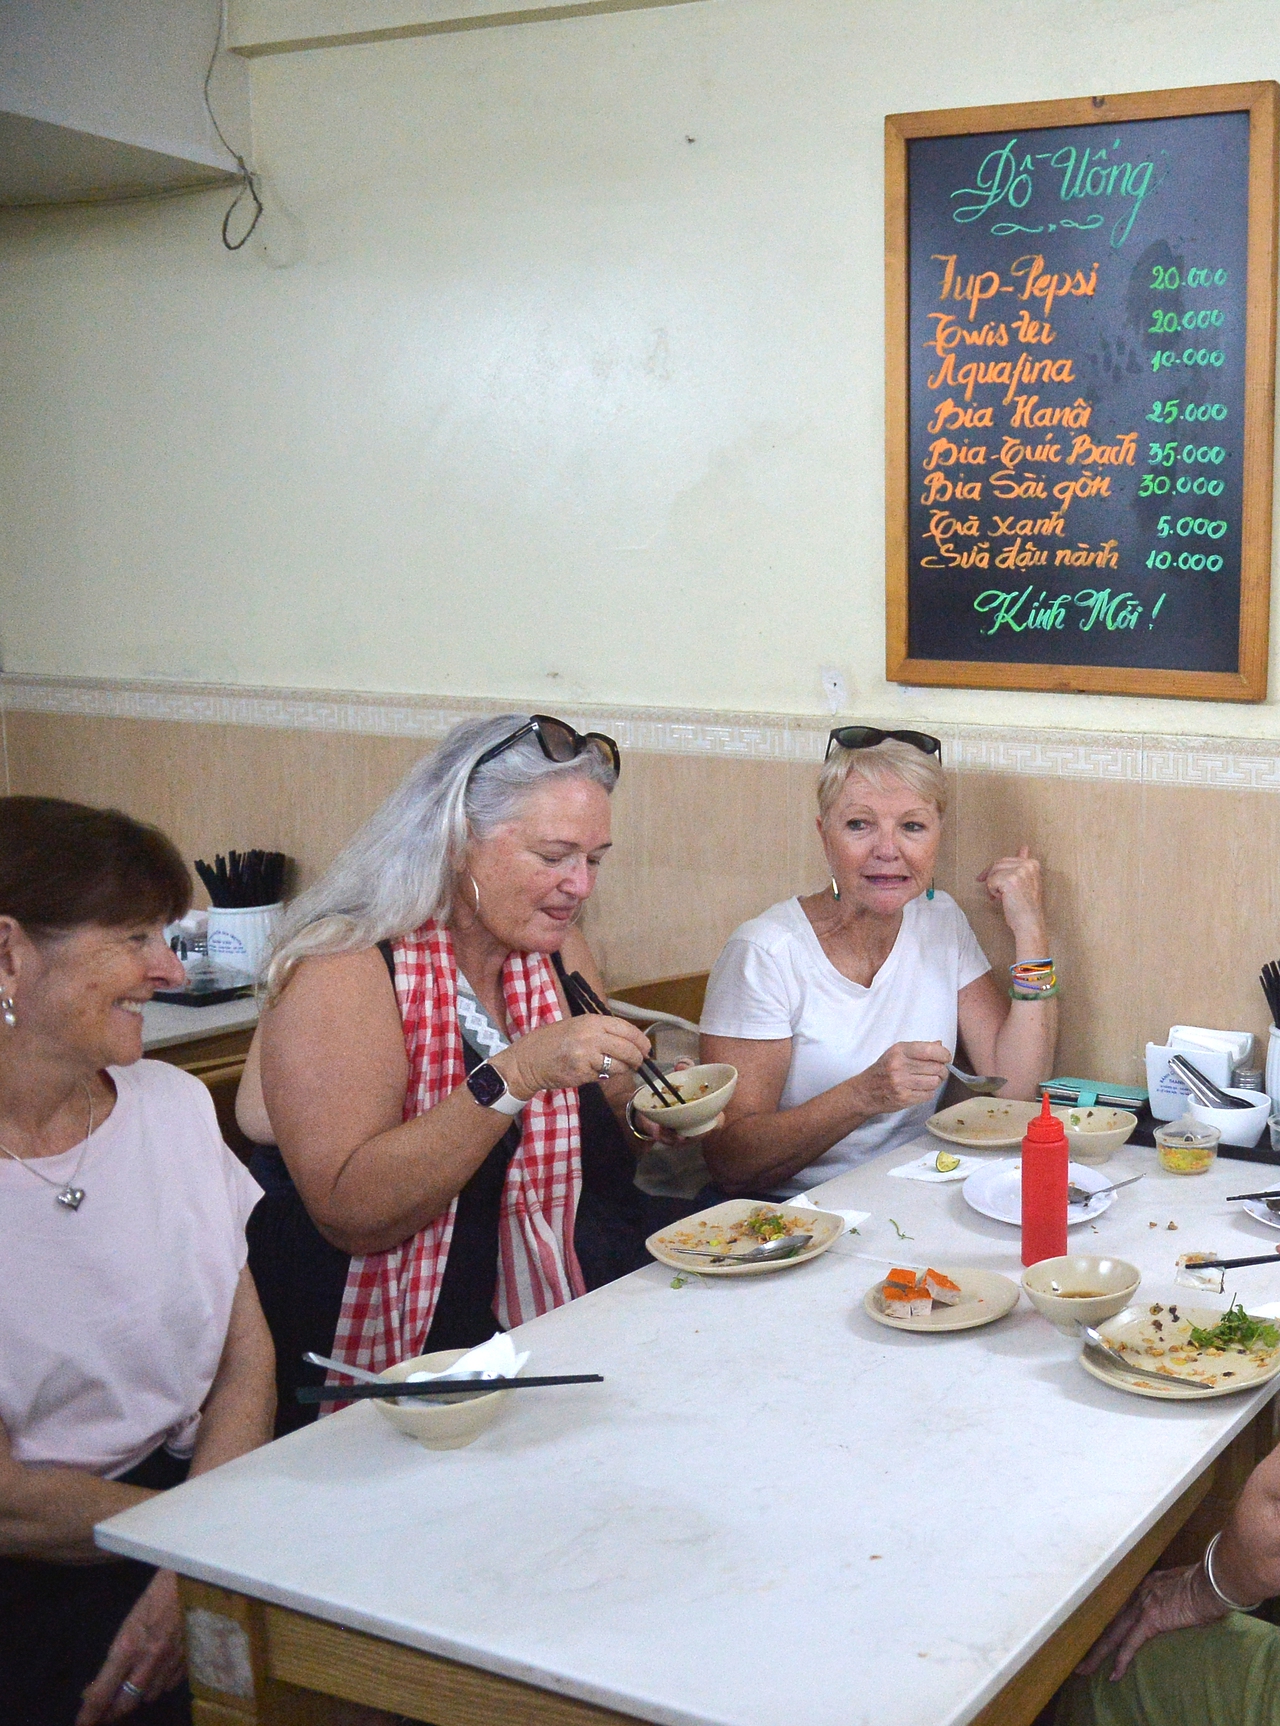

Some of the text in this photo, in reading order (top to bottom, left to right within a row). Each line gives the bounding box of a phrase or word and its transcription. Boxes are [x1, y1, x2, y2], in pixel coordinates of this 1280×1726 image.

[1148, 264, 1229, 291] 20.000
[1147, 307, 1226, 334] 20.000
[1150, 347, 1226, 372] 10.000
[926, 397, 994, 435] Bia
[1145, 398, 1229, 425] 25.000
[922, 436, 988, 471] Bia
[1147, 441, 1227, 468] 35.000
[920, 469, 1113, 515] Bia Sài gòn
[1137, 473, 1226, 498] 30.000
[987, 510, 1067, 538] xanh
[1156, 515, 1228, 540] 5.000
[1053, 538, 1120, 570] nành
[1145, 549, 1226, 573] 10.000
